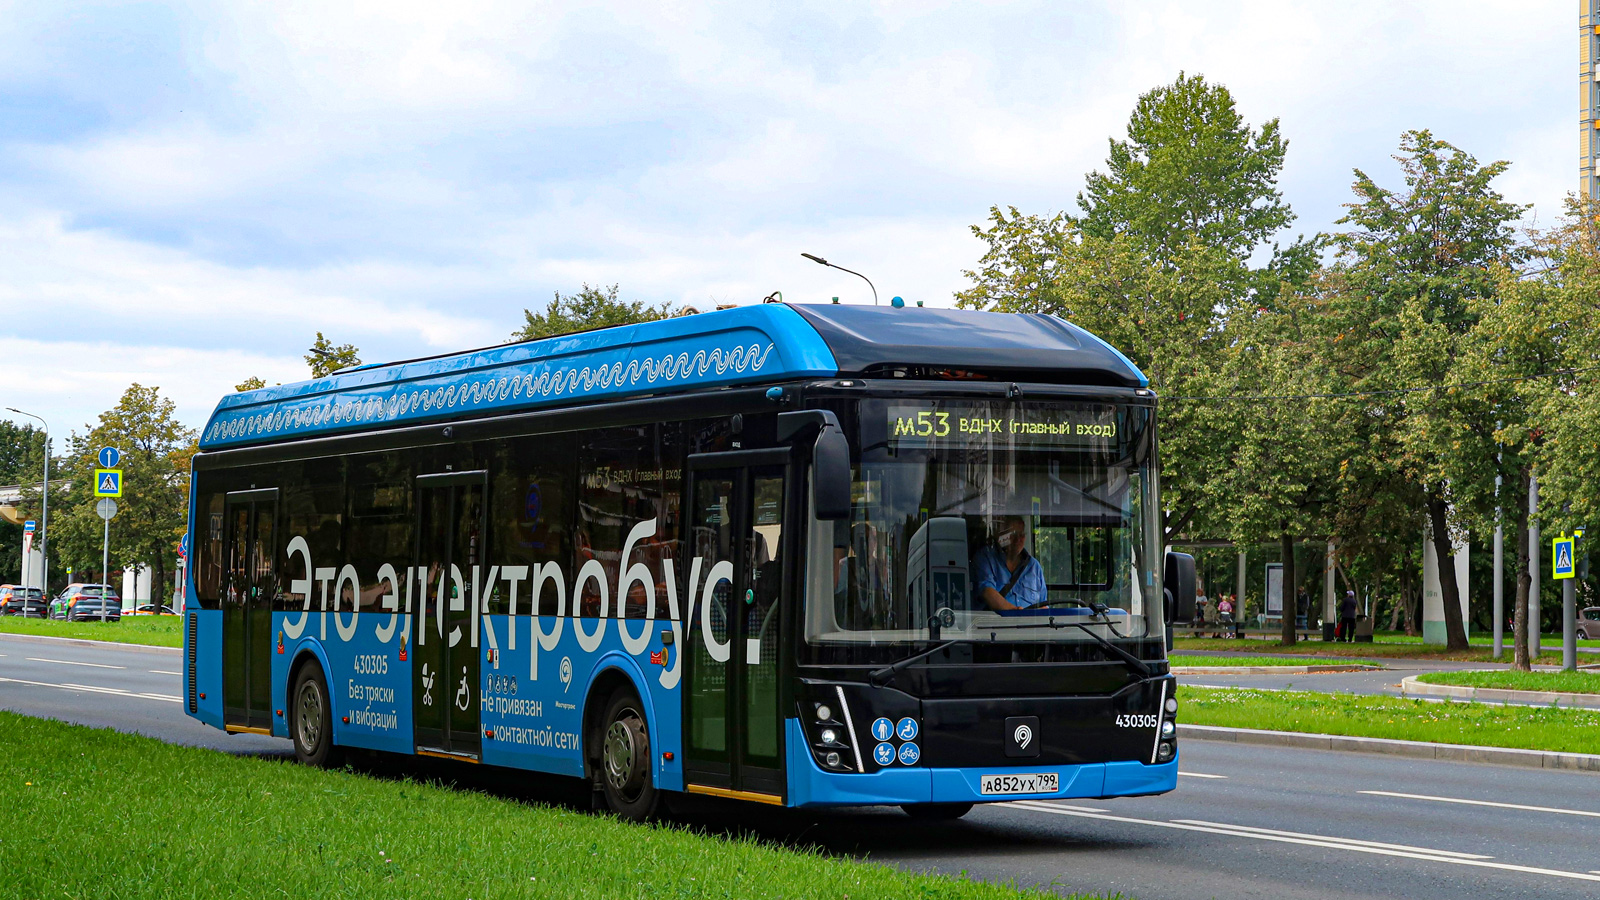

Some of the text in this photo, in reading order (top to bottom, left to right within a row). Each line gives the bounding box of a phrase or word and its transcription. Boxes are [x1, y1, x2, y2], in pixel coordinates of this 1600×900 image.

[959, 418, 1002, 433] ВДНХ
[1009, 419, 1070, 435] (главный
[1076, 422, 1116, 437] вход)
[282, 516, 761, 691] Это электробус.
[354, 655, 388, 675] 430305
[348, 679, 394, 706] Без тряски
[480, 689, 494, 712] Не
[495, 696, 543, 719] привязан
[349, 705, 398, 731] и вибраций
[1115, 714, 1158, 728] 430305
[493, 725, 553, 748] контактной
[554, 731, 580, 751] сети
[1037, 774, 1056, 787] 799
